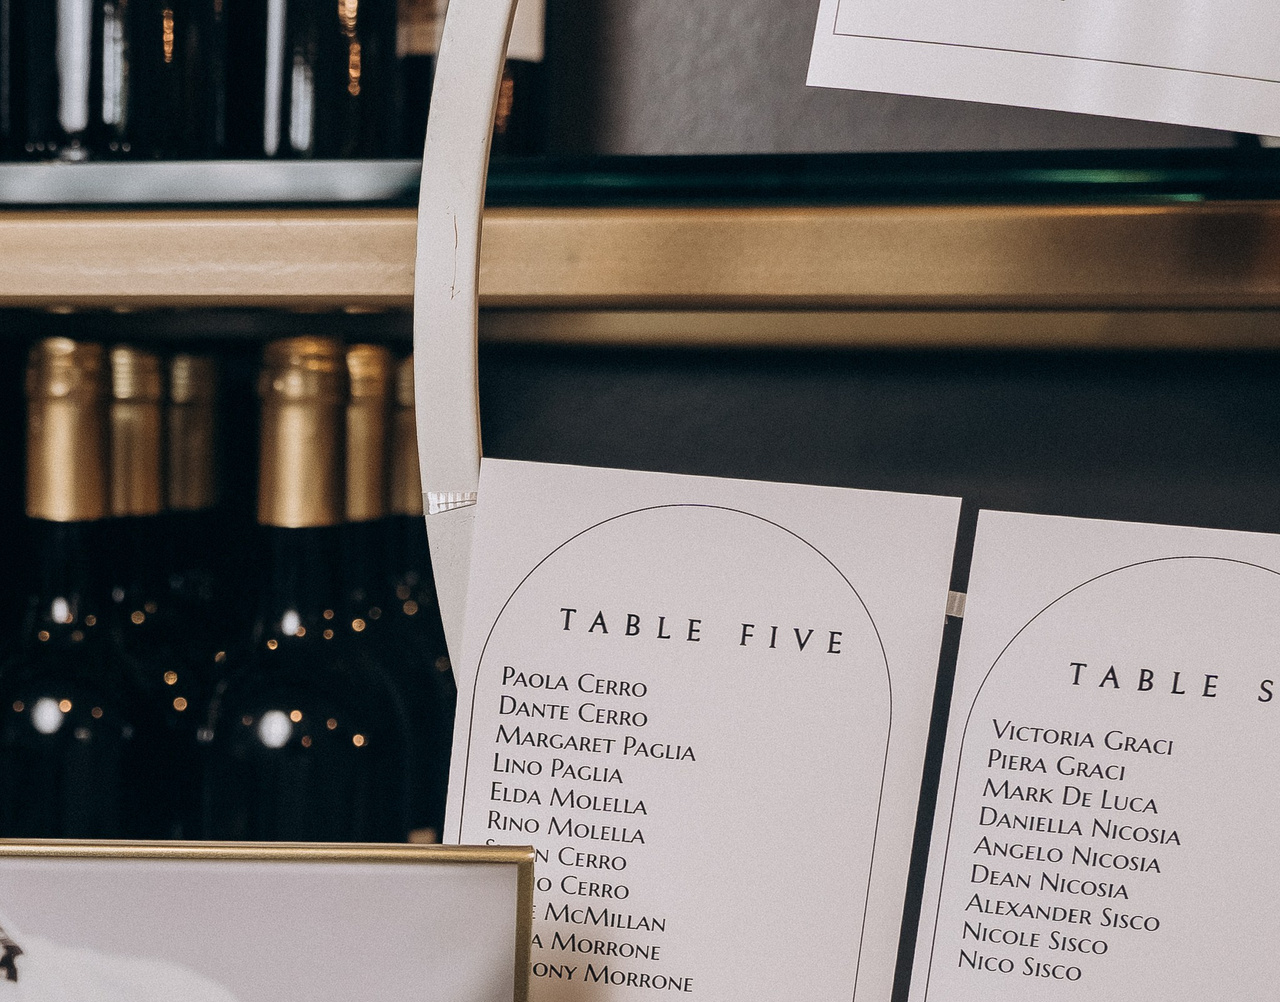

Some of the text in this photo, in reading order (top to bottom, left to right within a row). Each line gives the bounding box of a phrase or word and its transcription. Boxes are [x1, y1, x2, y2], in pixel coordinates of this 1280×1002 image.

[559, 607, 843, 655] TABLE FIVE
[501, 665, 648, 698] PAOLA CERRO
[1069, 661, 1219, 698] TABLE
[498, 694, 648, 728] DANTE CERRO
[495, 724, 696, 762] MARGARET PAGLIA
[992, 718, 1174, 756] VICTORIA GRACI
[493, 752, 624, 784] LINO PAGLIA
[987, 748, 1126, 781] PIERA GRACI
[490, 781, 648, 816] ELDA MOLELLA
[982, 777, 1159, 815] MARK DE LUCA
[487, 809, 646, 845] RINO MOLELLA
[978, 805, 1182, 846] DANIELLA NICOSIA
[557, 846, 627, 871] CERRO
[972, 835, 1161, 874] ANGELO NICOSIA
[560, 875, 630, 900] CERRO
[970, 863, 1129, 900] DEAN NICOSIA
[964, 892, 1161, 932] ALEXANDER SISCO
[550, 931, 661, 961] MORRONE
[962, 920, 1109, 955] NICOLE SISCO
[583, 963, 694, 993] MORRONE
[958, 948, 1082, 982] NICO SISCO
